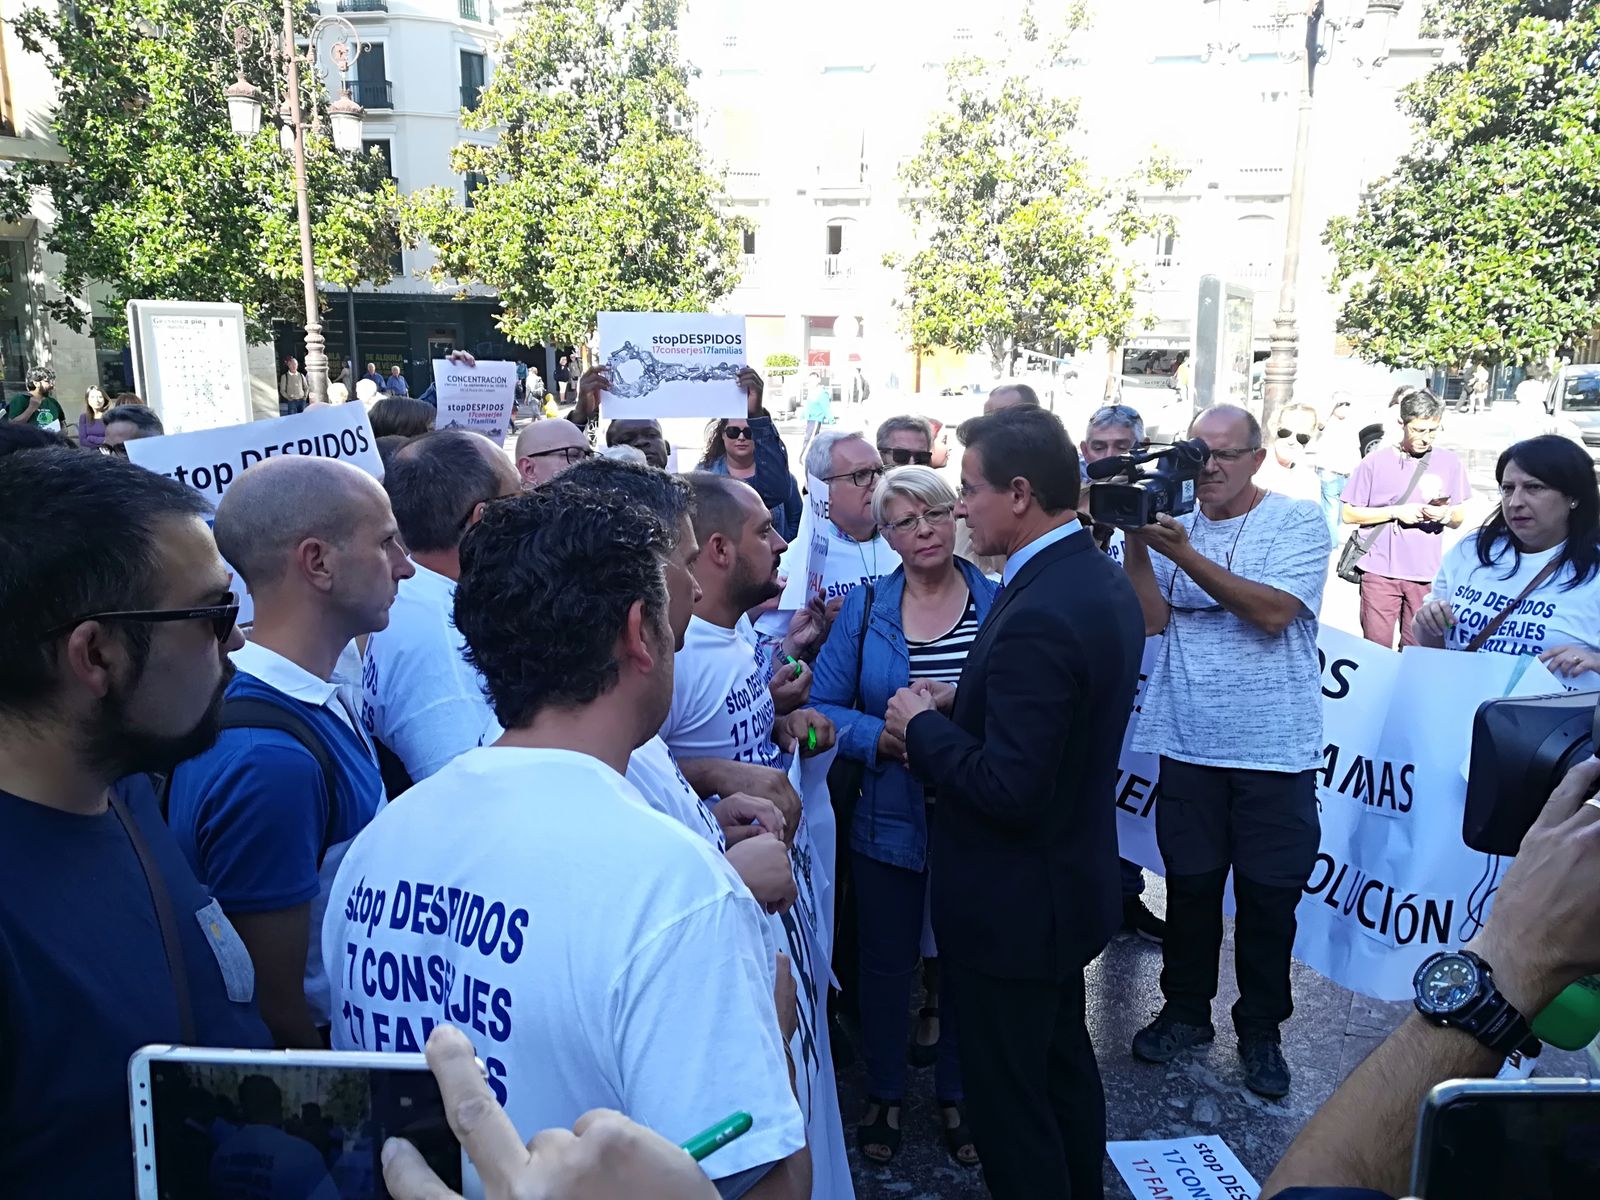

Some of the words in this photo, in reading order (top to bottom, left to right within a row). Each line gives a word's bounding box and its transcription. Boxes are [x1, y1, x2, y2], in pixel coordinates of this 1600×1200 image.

[652, 334, 742, 346] stopDESPIDOS
[447, 375, 507, 384] CONCENTRACIÓN
[447, 403, 504, 412] stopDESPIDOS
[164, 463, 234, 493] top
[1455, 584, 1483, 605] stop
[730, 720, 749, 748] 17
[344, 875, 387, 938] stop
[389, 880, 530, 964] DESPIDOS
[1132, 1158, 1155, 1174] 17
[1162, 1148, 1187, 1165] 17
[1193, 1142, 1224, 1173] stop
